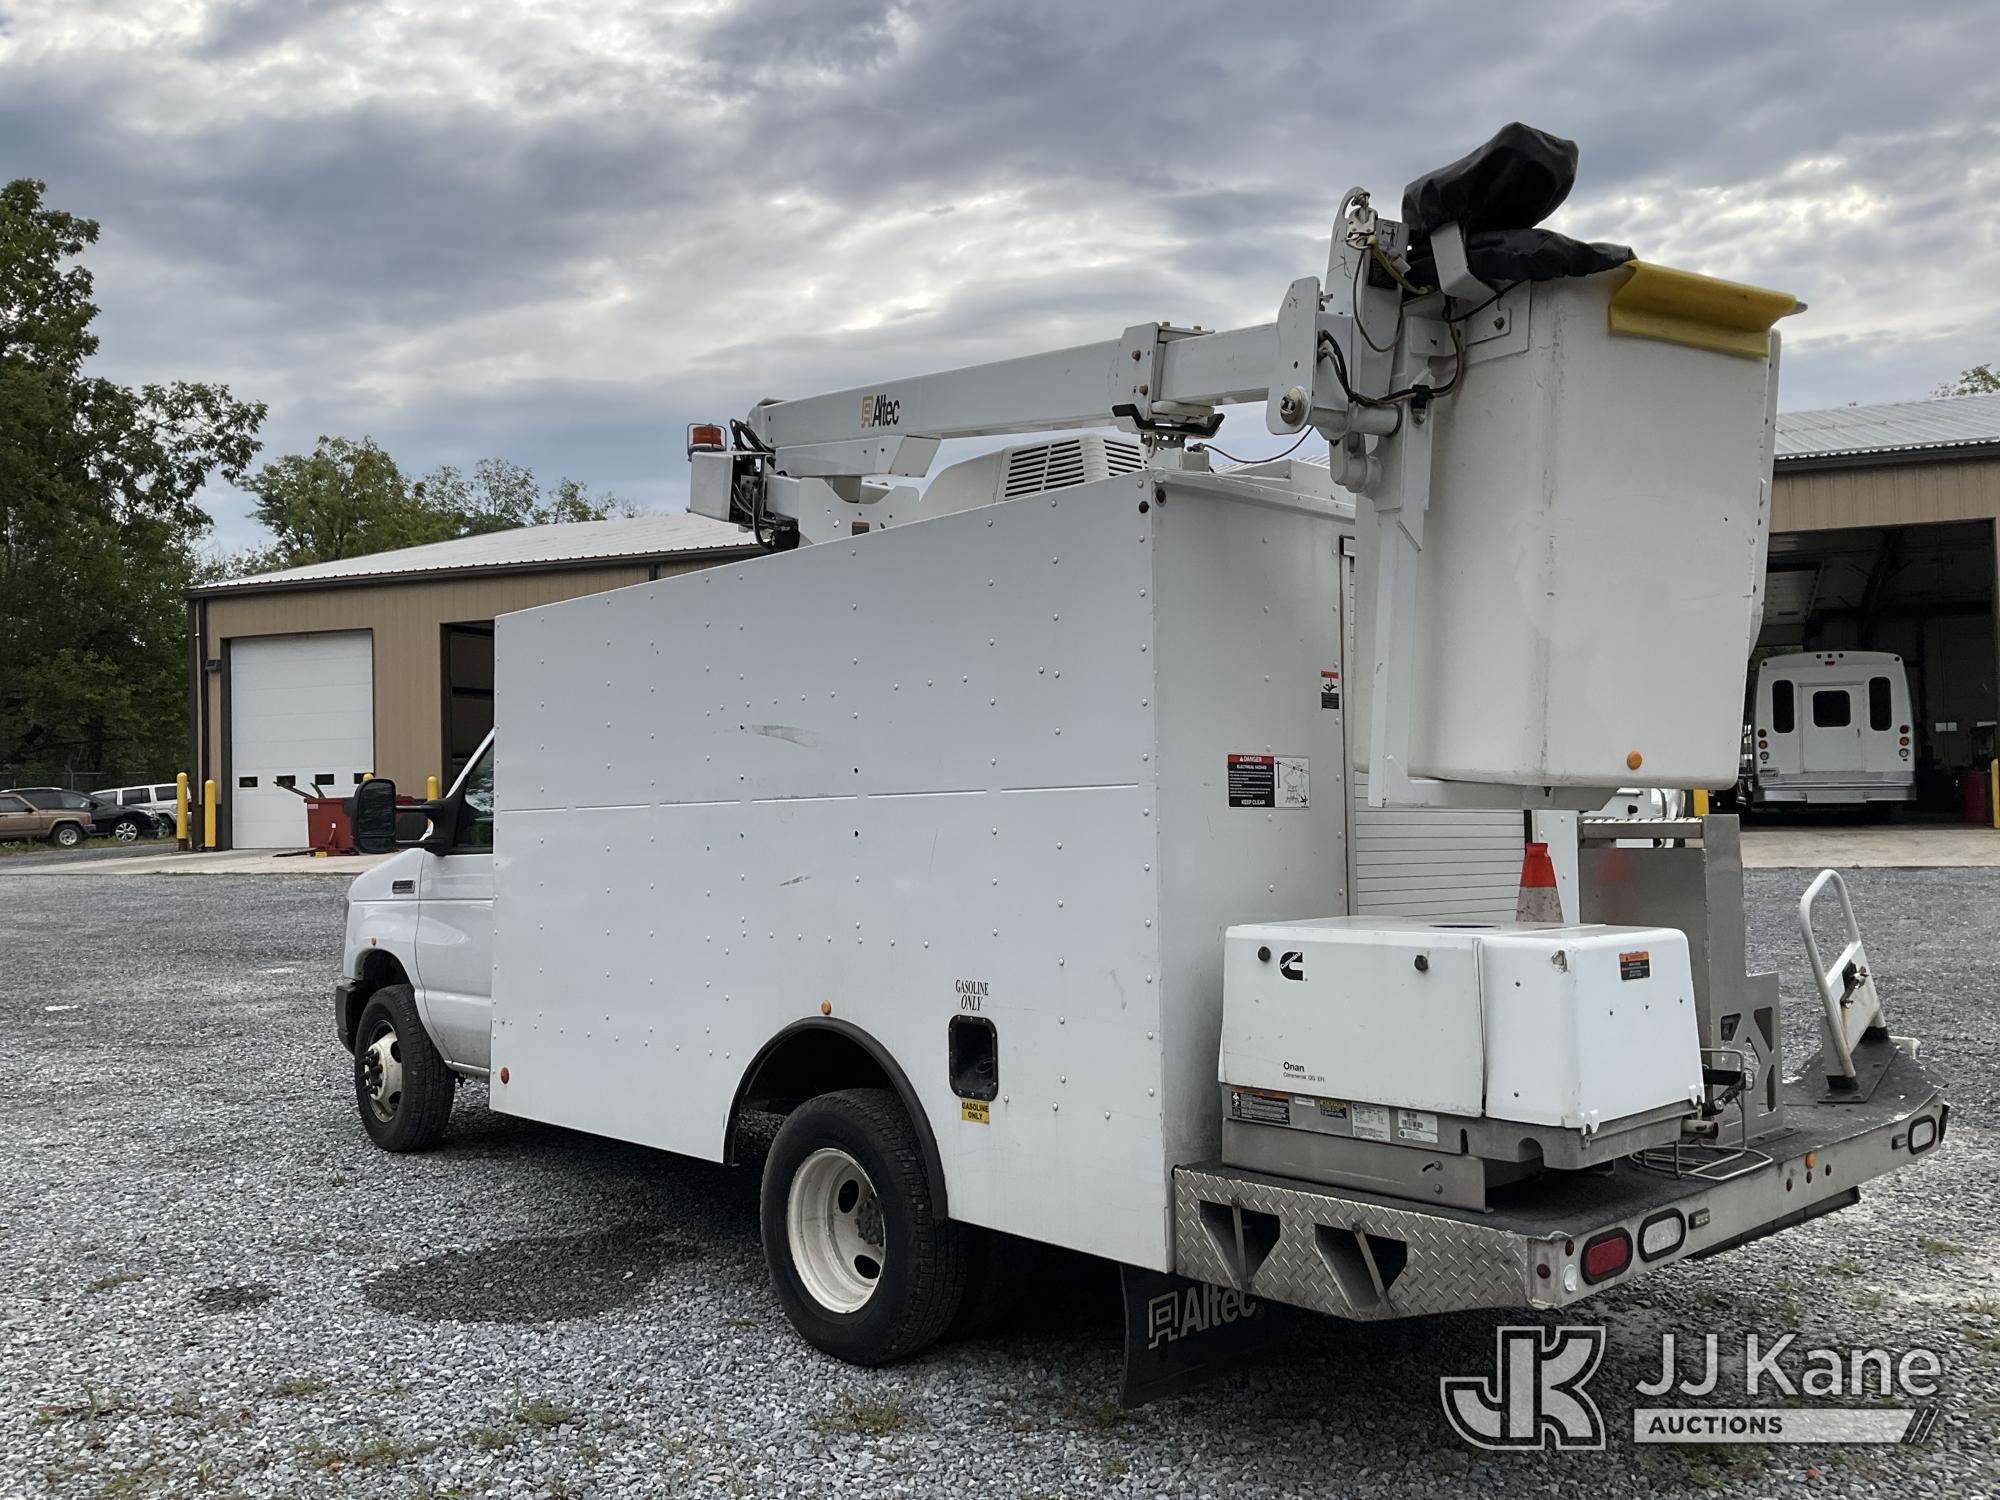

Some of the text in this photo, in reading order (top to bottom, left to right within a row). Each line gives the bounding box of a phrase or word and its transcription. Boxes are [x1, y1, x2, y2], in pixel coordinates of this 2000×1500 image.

[872, 394, 900, 427] Altec
[955, 979, 989, 996] GASOLINE
[961, 994, 983, 1012] ONLY
[1283, 1061, 1305, 1072] Onan
[962, 1102, 989, 1113] GASOLINE
[968, 1111, 983, 1120] ONLY
[1180, 1283, 1257, 1338] Altec
